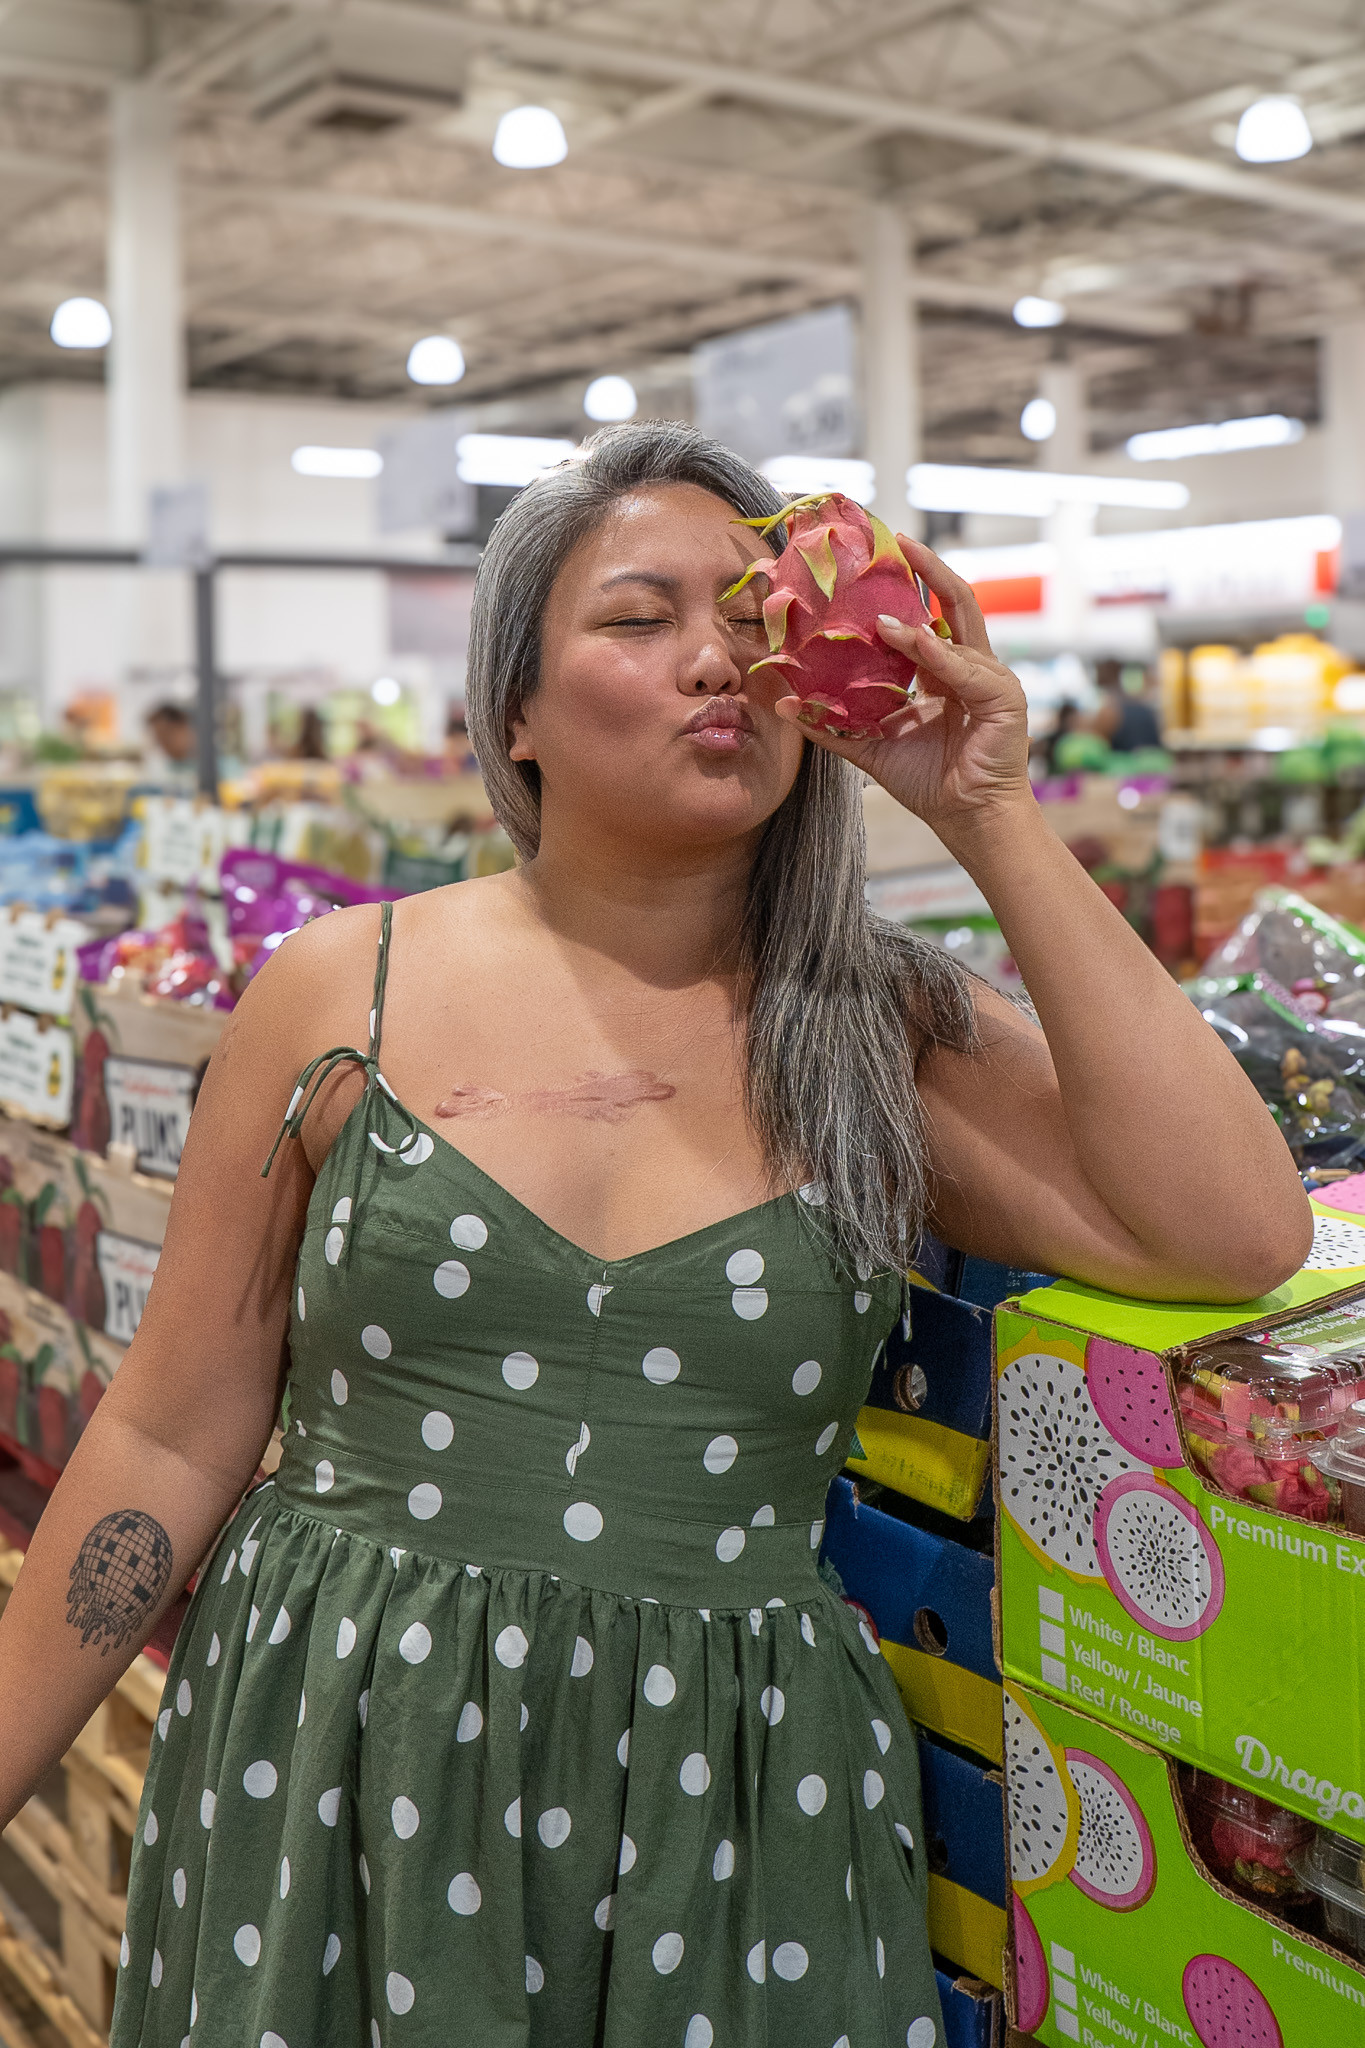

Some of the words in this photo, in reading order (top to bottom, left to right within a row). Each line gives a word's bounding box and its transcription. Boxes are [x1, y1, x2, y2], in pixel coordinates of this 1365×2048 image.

[1210, 1505, 1328, 1565] Premium
[1069, 1604, 1123, 1647] White
[1126, 1632, 1134, 1651] /
[1138, 1634, 1190, 1676] Blanc
[1070, 1674, 1105, 1708] Red
[1109, 1694, 1117, 1712] /
[1119, 1697, 1181, 1744] Rouge
[1071, 1640, 1130, 1684] Yellow
[1132, 1670, 1141, 1690] /
[1143, 1674, 1203, 1718] Jaune
[1235, 1734, 1365, 1820] Drago
[1080, 1963, 1131, 2010] White
[1133, 1997, 1141, 2015] /
[1143, 2001, 1193, 2048] Blanc
[1272, 1938, 1365, 2008] Premium
[1082, 1996, 1138, 2044] Yellow
